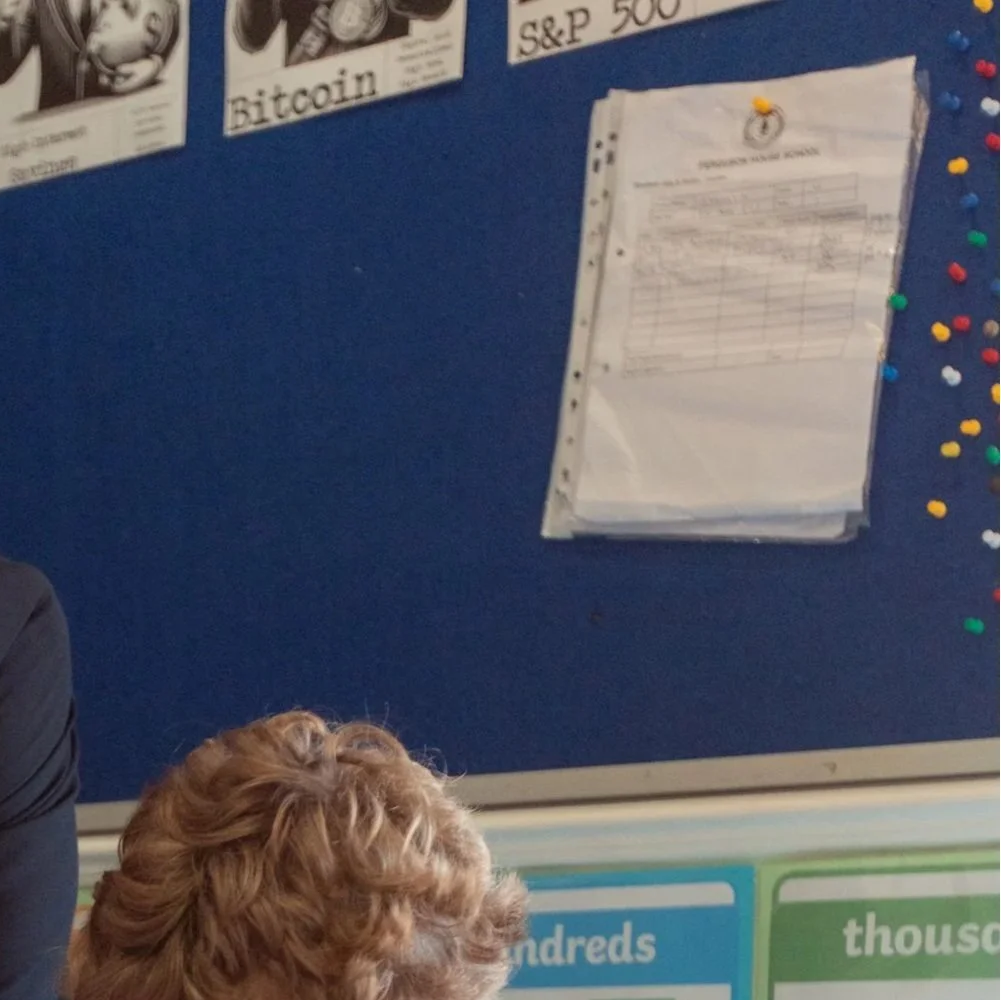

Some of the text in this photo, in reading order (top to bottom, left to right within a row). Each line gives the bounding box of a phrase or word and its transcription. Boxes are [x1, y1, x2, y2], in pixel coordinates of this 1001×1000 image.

[517, 0, 681, 57] S&P 500
[227, 69, 379, 131] Bitcoin
[507, 920, 657, 968] ndreds
